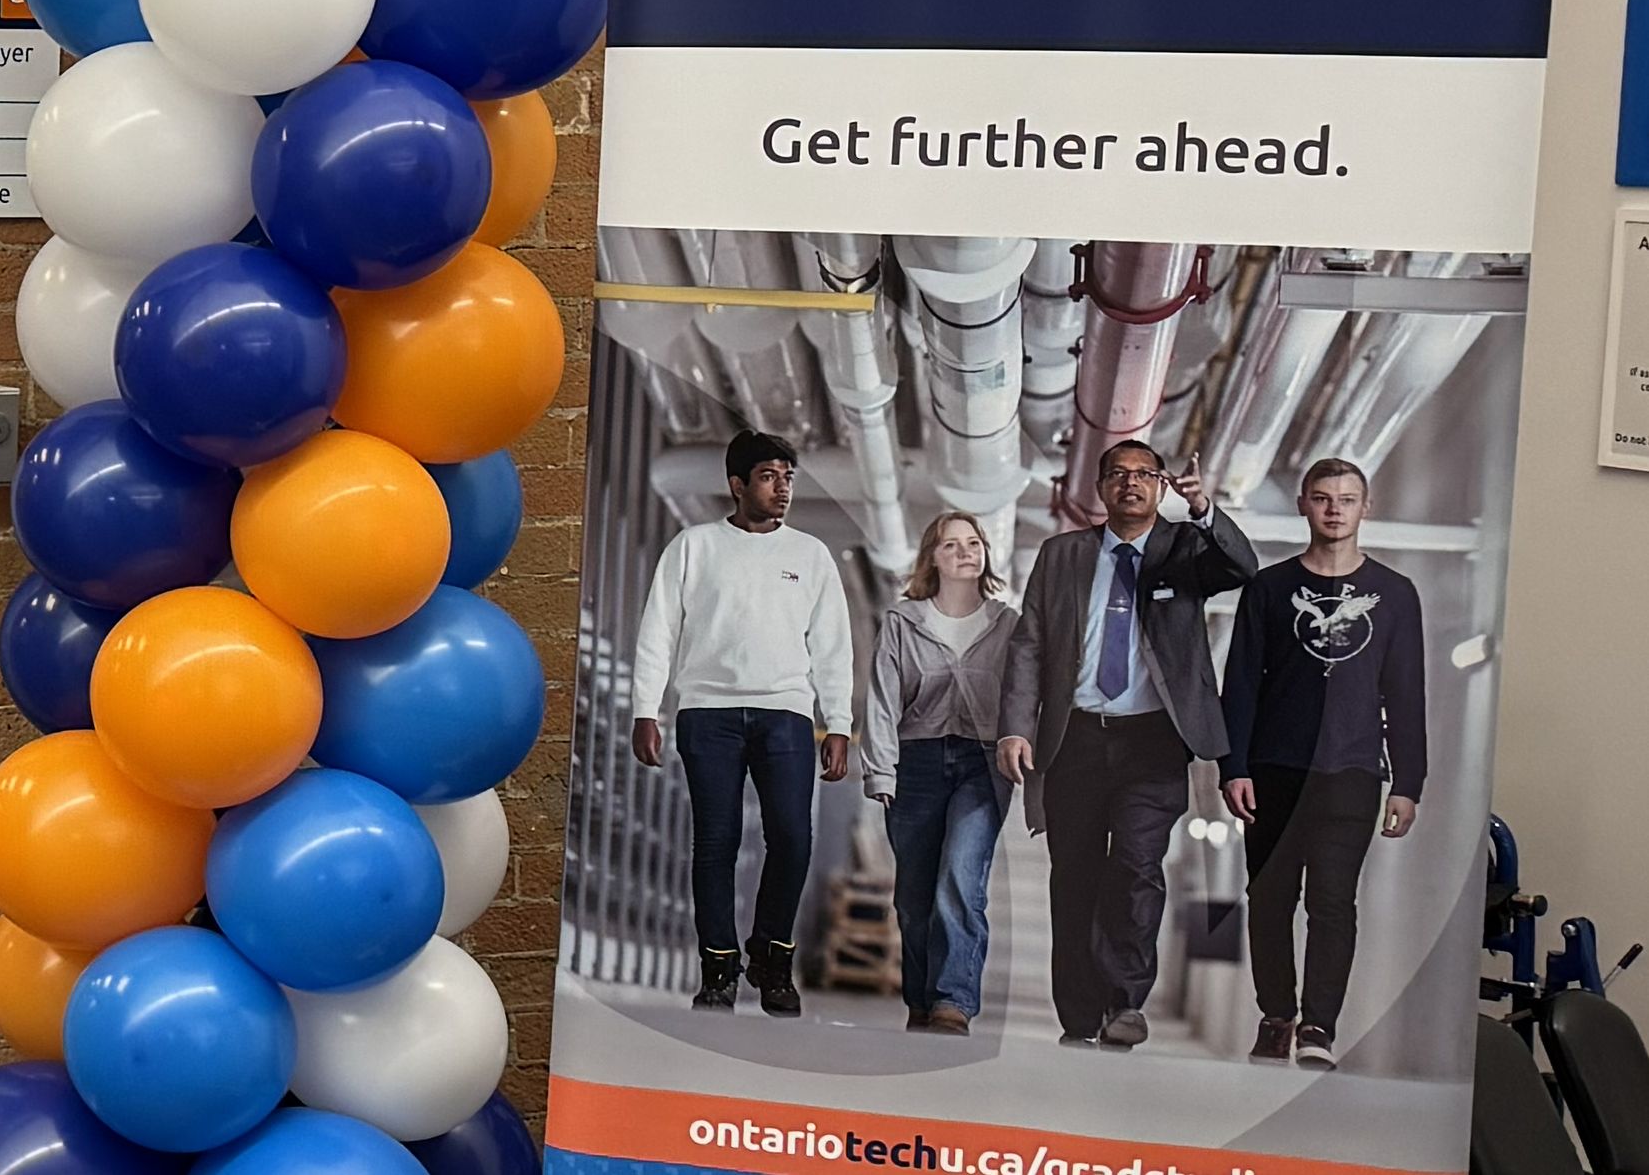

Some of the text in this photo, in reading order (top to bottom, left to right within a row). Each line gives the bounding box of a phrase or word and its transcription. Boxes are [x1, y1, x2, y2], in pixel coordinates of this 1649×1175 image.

[761, 114, 1351, 179] Get further ahead.
